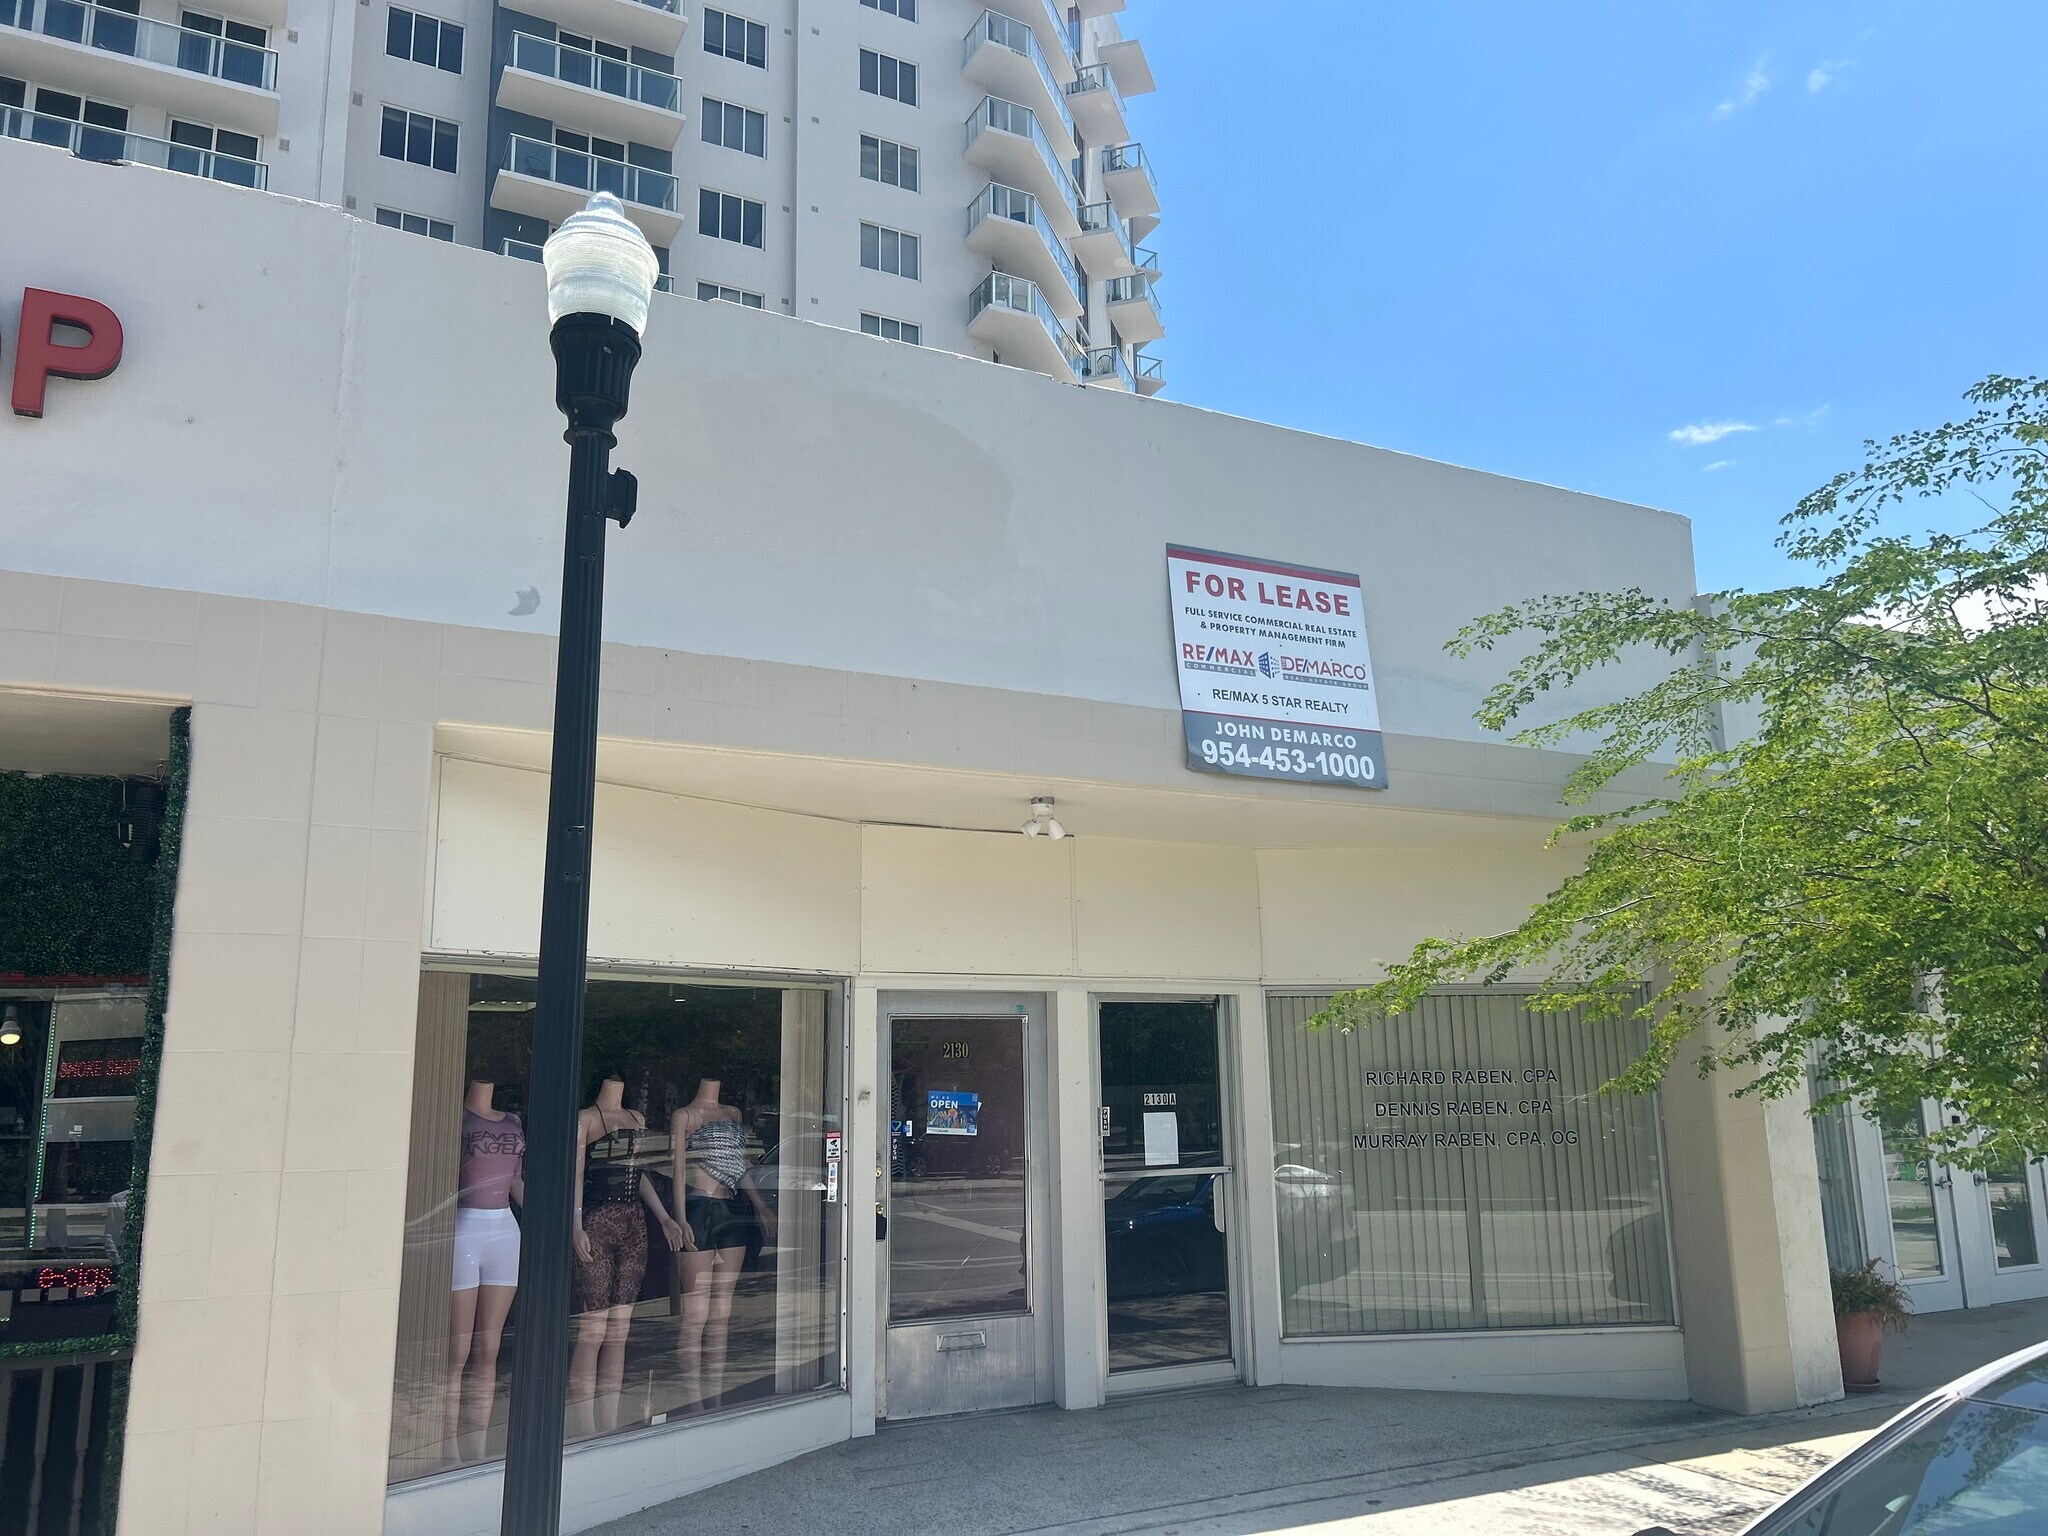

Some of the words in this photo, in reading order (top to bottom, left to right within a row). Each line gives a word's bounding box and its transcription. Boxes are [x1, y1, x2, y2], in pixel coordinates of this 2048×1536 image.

[0, 286, 124, 419] P
[1186, 571, 1247, 601] FOR
[1258, 582, 1350, 616] LEASE
[1185, 607, 1206, 617] FULL
[1208, 610, 1242, 622] SERVICE
[1245, 615, 1303, 631] COMMERCIAL
[1305, 624, 1327, 634] REAL
[1328, 628, 1357, 638] ESTATE
[1200, 621, 1207, 629] &
[1210, 623, 1256, 636] PROPERTY
[1259, 629, 1324, 644] MANAGEMENT
[1325, 639, 1346, 648] FIRM
[1182, 643, 1255, 667] RE/MAX
[1186, 662, 1255, 676] COMMERCIAL
[1212, 688, 1259, 704] RE/MAX
[1262, 694, 1269, 705] 5
[1271, 695, 1302, 709] STAR
[1305, 699, 1349, 714] REALTY
[1215, 721, 1265, 740] JOHN
[1271, 727, 1357, 749] DEMARCO
[1201, 739, 1375, 780] 954-453-1000
[943, 1042, 969, 1059] 2130
[1365, 1071, 1445, 1086] RICHARD
[1451, 1069, 1518, 1087] RABEN,
[1522, 1069, 1558, 1084] CPA
[930, 1099, 959, 1109] OPEN
[1375, 1102, 1441, 1117] DENNIS
[1446, 1100, 1513, 1117] RABEN,
[1518, 1100, 1554, 1115] CPA
[1353, 1133, 1429, 1149] MURRAY
[1434, 1132, 1501, 1150] RABEN,
[1506, 1131, 1546, 1147] CPA,
[1551, 1130, 1579, 1145] OG
[38, 1262, 113, 1296] e-cigs
